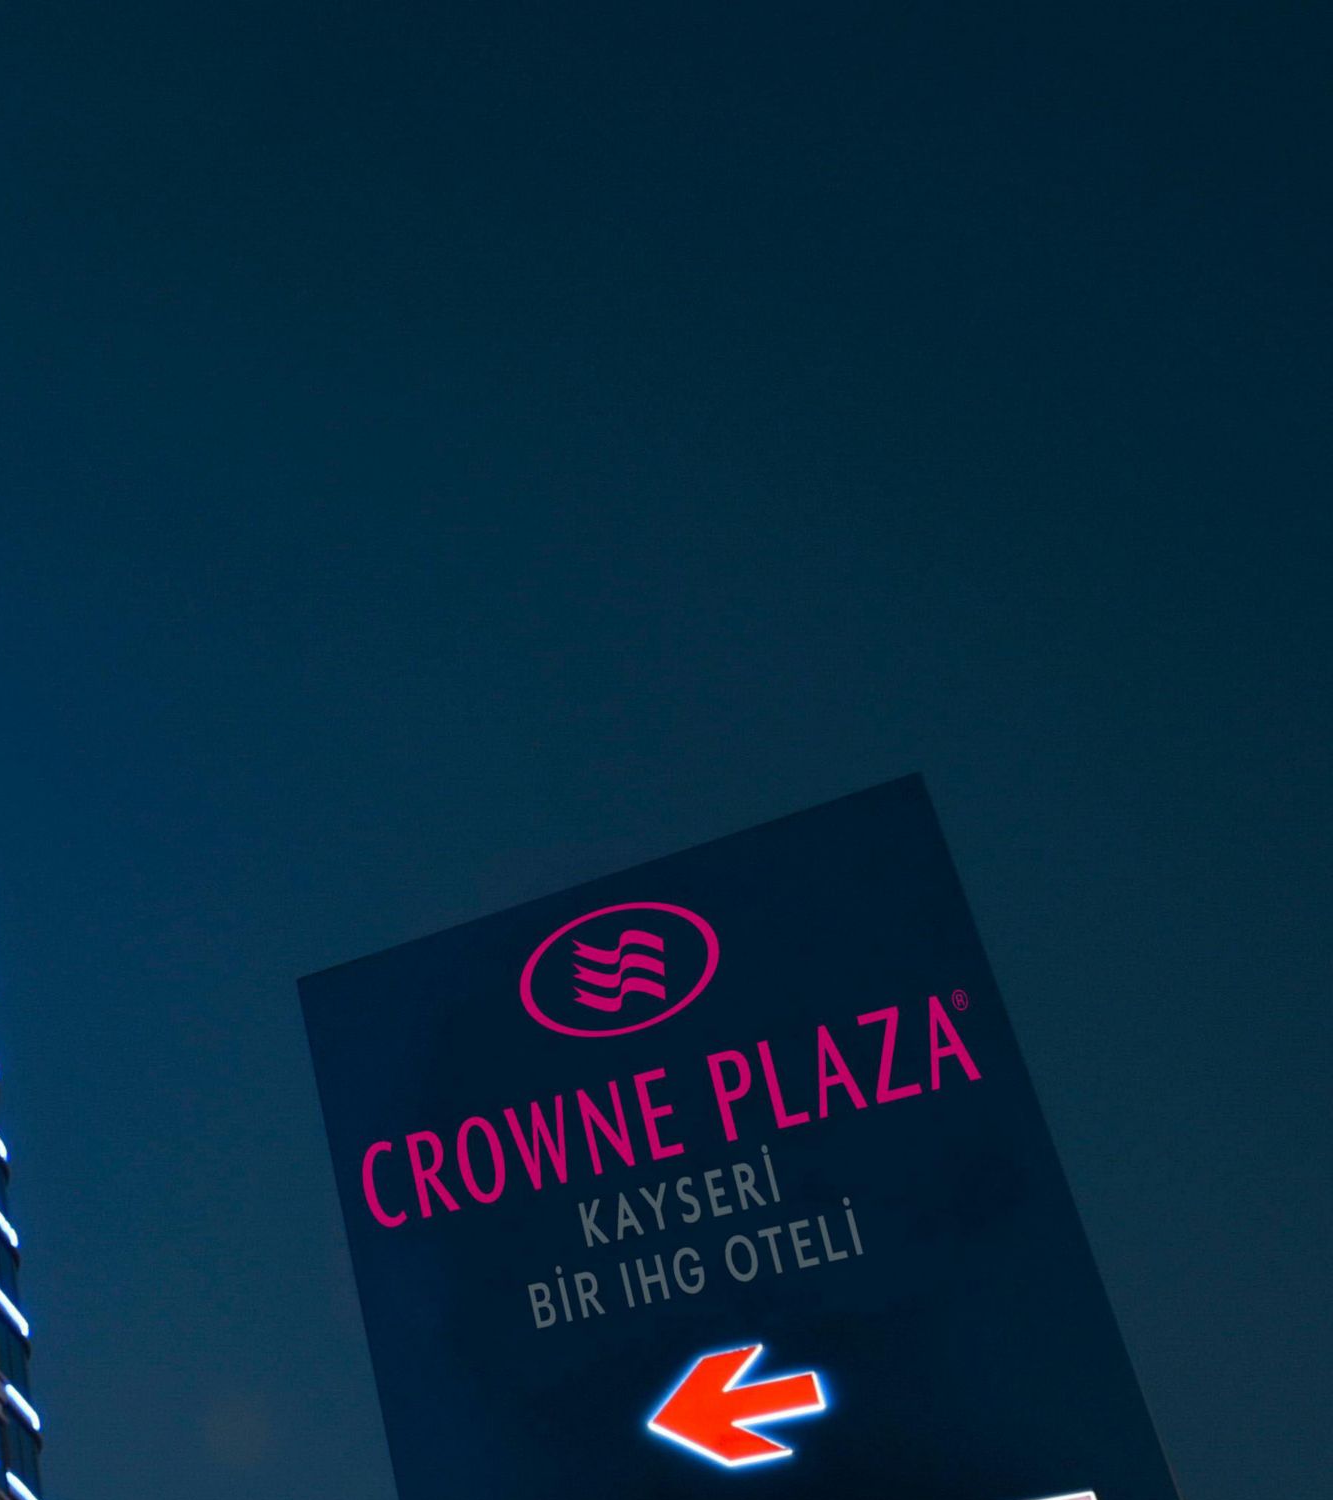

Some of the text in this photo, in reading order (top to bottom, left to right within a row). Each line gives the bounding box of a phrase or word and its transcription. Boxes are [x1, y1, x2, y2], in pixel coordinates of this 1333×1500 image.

[361, 1068, 685, 1229] CROWNE
[577, 1144, 783, 1249] KAYSERİ
[619, 1246, 706, 1309] IHG
[723, 1196, 865, 1284] OTELİ
